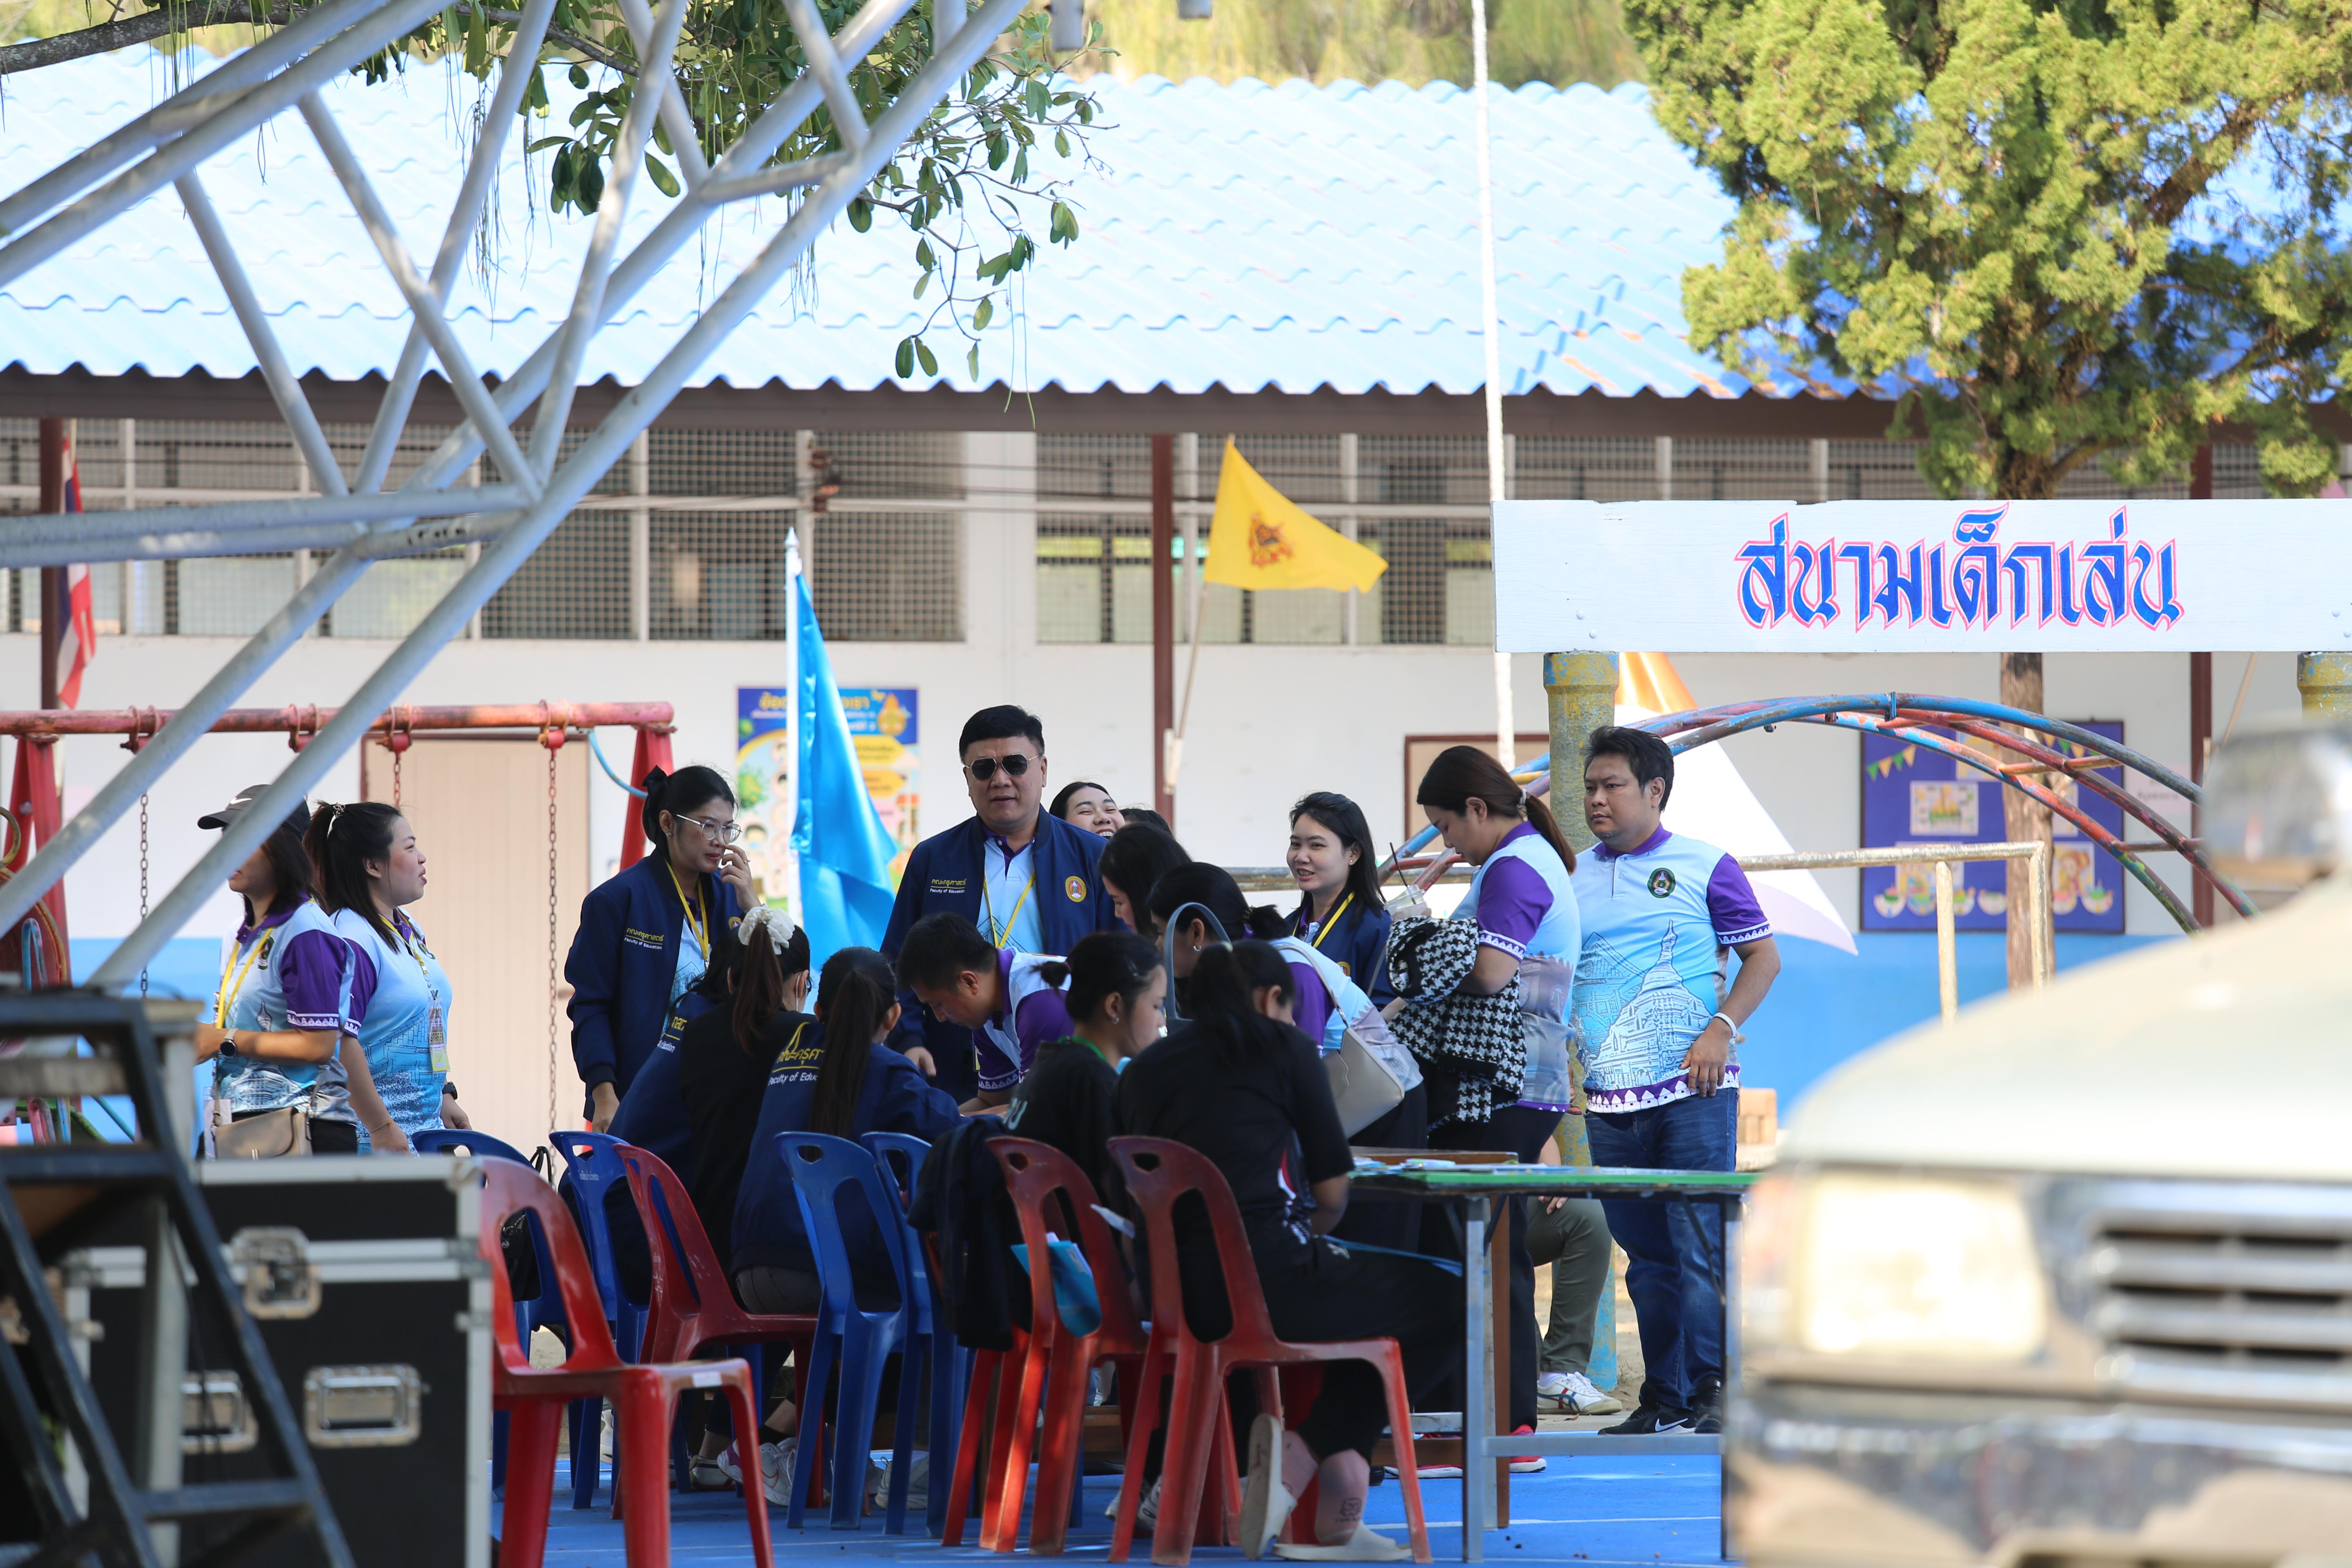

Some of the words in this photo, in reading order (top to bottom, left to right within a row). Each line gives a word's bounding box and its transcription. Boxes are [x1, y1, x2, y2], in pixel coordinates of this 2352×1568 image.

[1733, 501, 2184, 633] สนามเด็กเล่น
[627, 928, 664, 941] คณะครุศาสตร์
[789, 1072, 799, 1082] of
